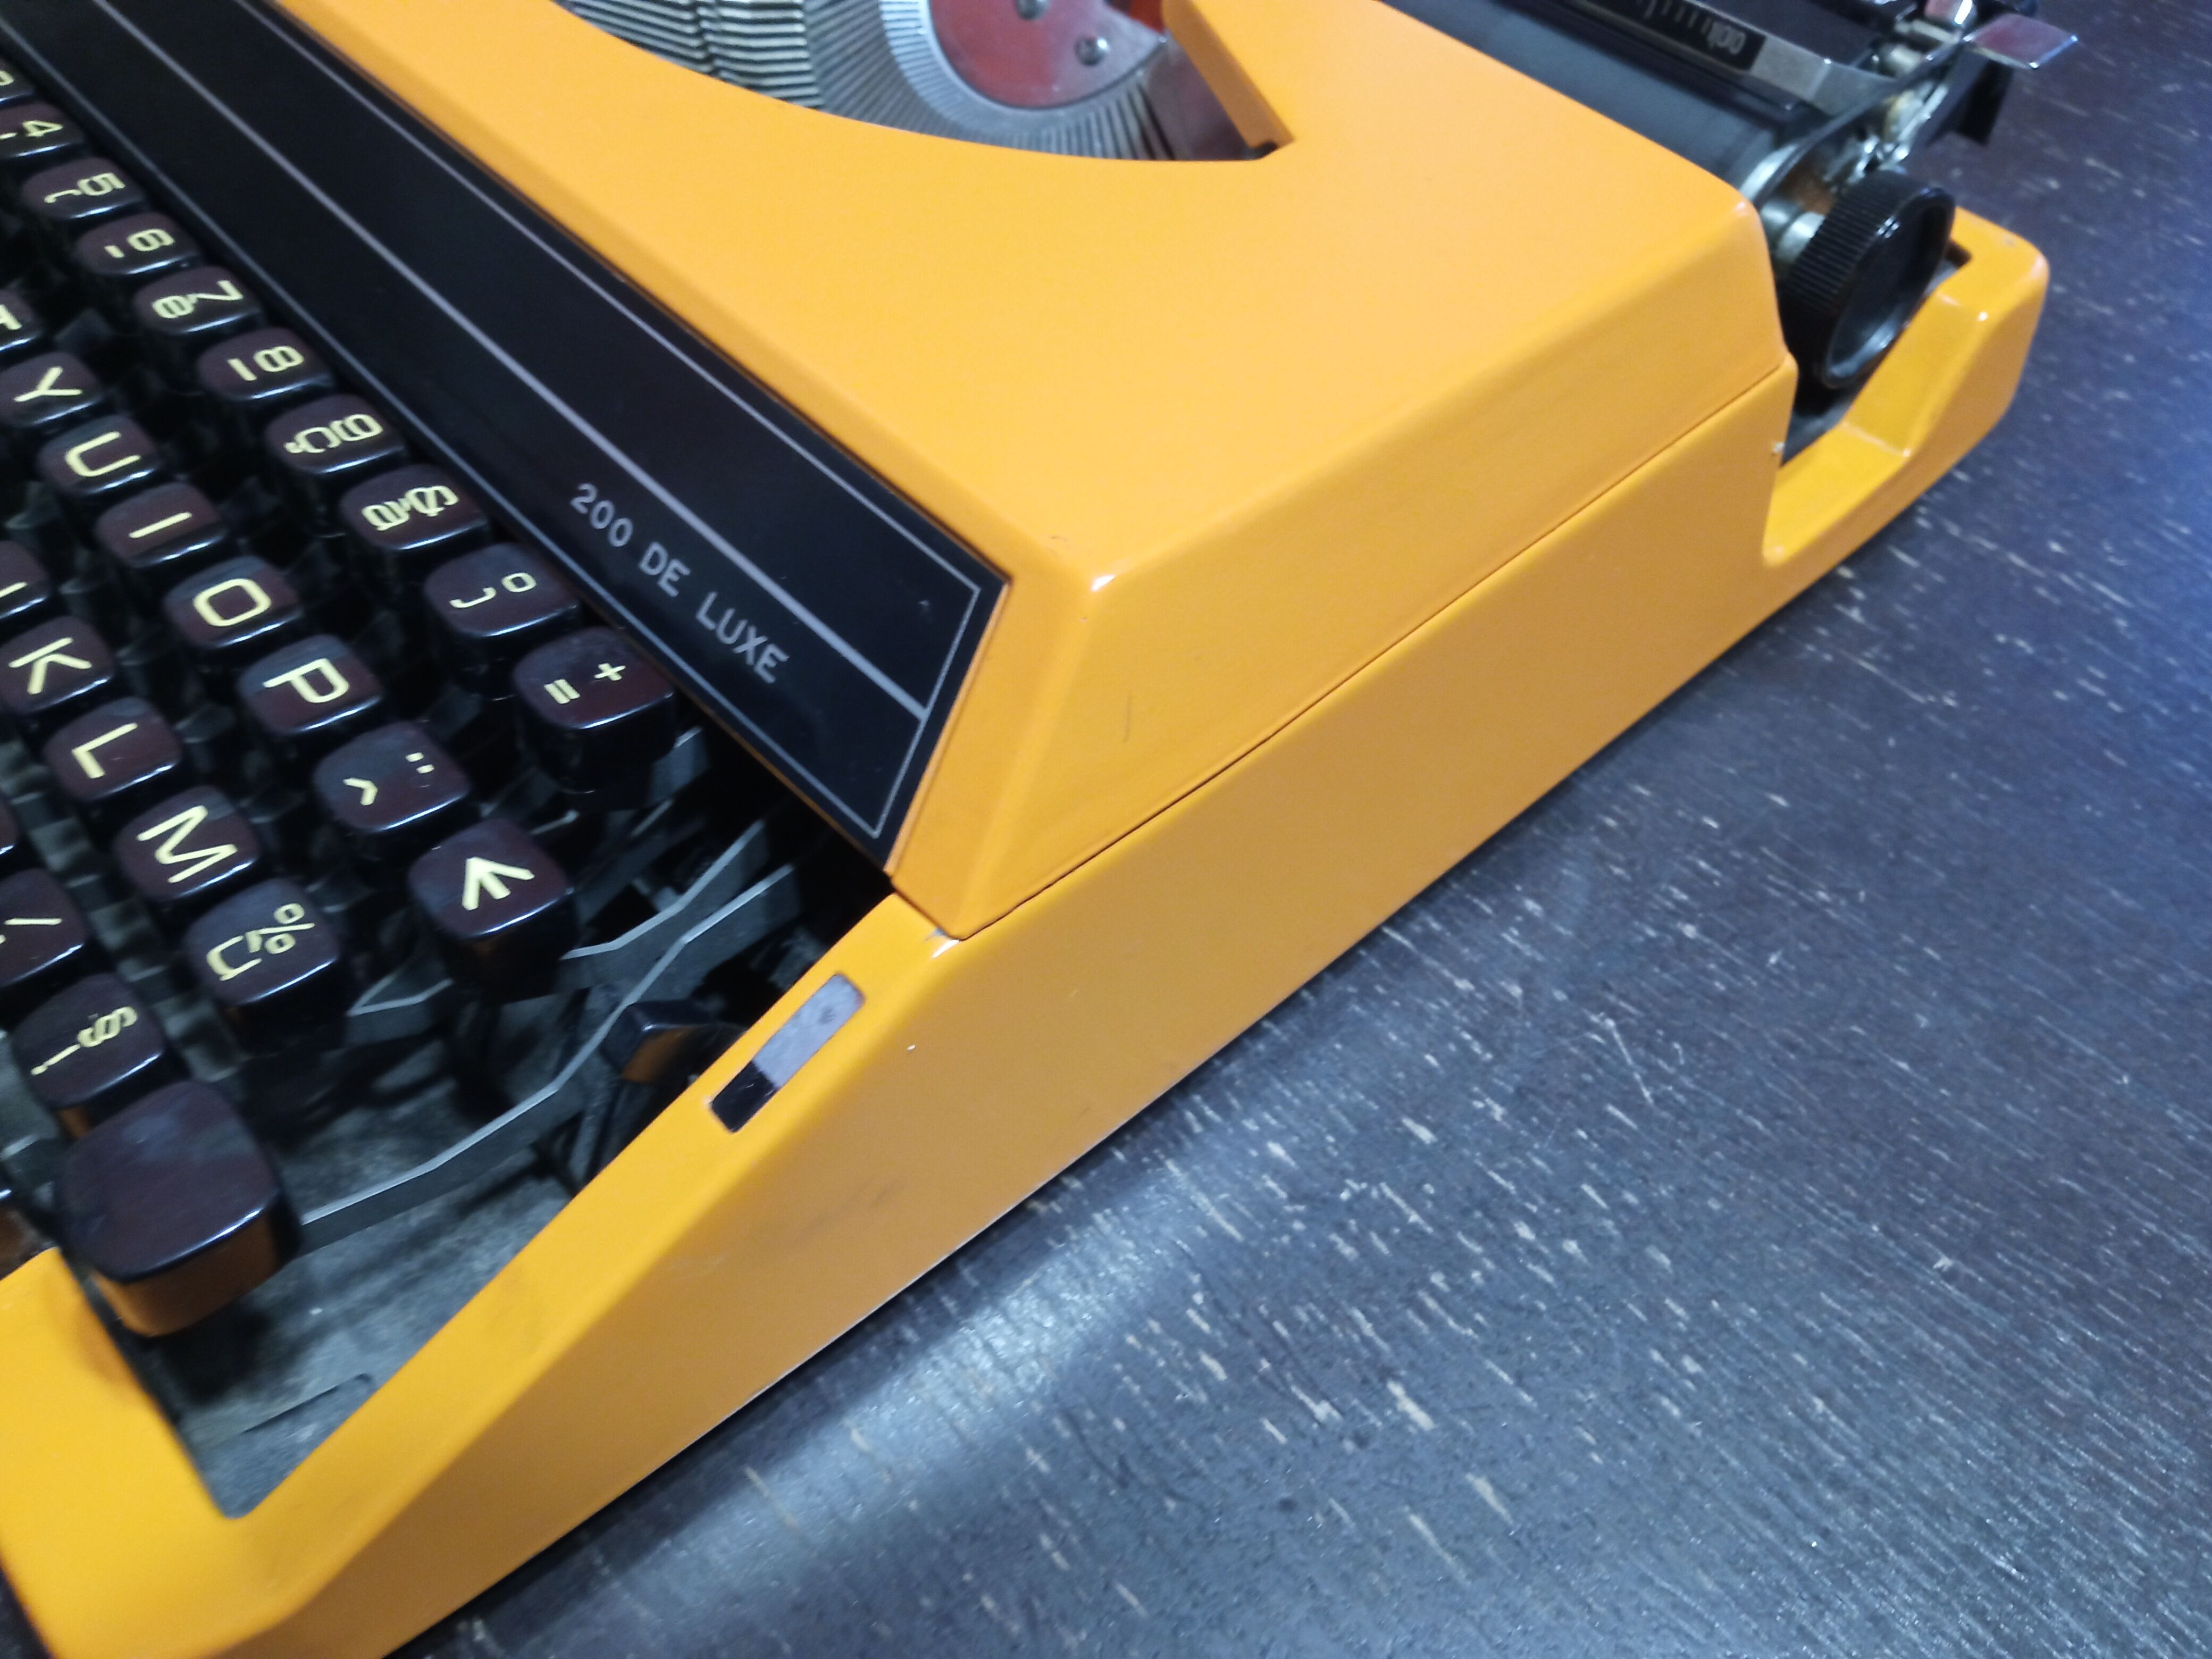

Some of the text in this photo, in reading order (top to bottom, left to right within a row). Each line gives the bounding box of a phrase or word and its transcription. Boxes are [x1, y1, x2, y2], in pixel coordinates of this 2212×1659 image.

[22, 120, 63, 137] 4
[77, 172, 125, 196] 5
[127, 228, 175, 252] 6
[192, 279, 244, 301] 7
[253, 345, 305, 372] 8
[14, 366, 83, 403] Y
[64, 431, 141, 477] U
[570, 483, 790, 684] 200 DE LUXE
[8, 637, 93, 695] K
[262, 657, 349, 703] P
[71, 722, 138, 780] L
[136, 805, 239, 884] M
